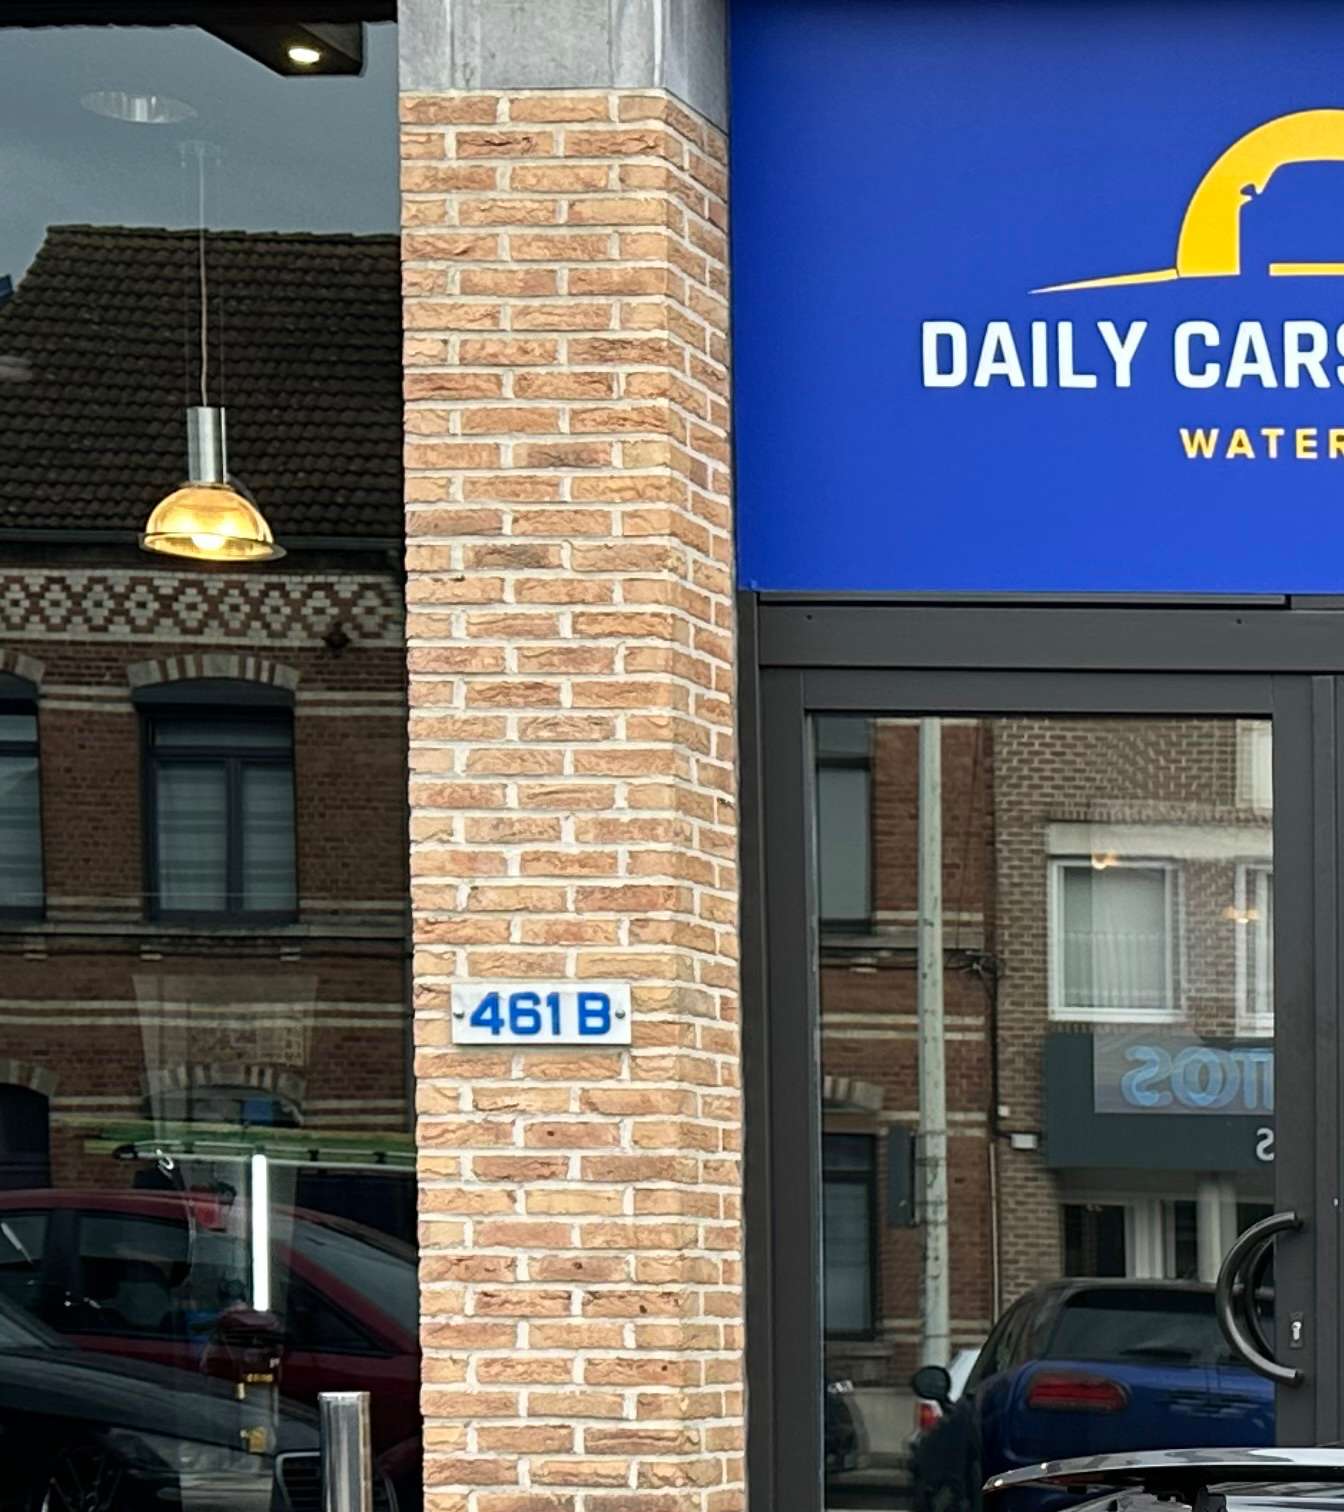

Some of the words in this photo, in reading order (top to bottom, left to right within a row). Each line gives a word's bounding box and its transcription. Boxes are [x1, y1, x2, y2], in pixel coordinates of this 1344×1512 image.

[922, 321, 1148, 389] DAILY
[469, 991, 562, 1036] 461
[577, 991, 611, 1036] B
